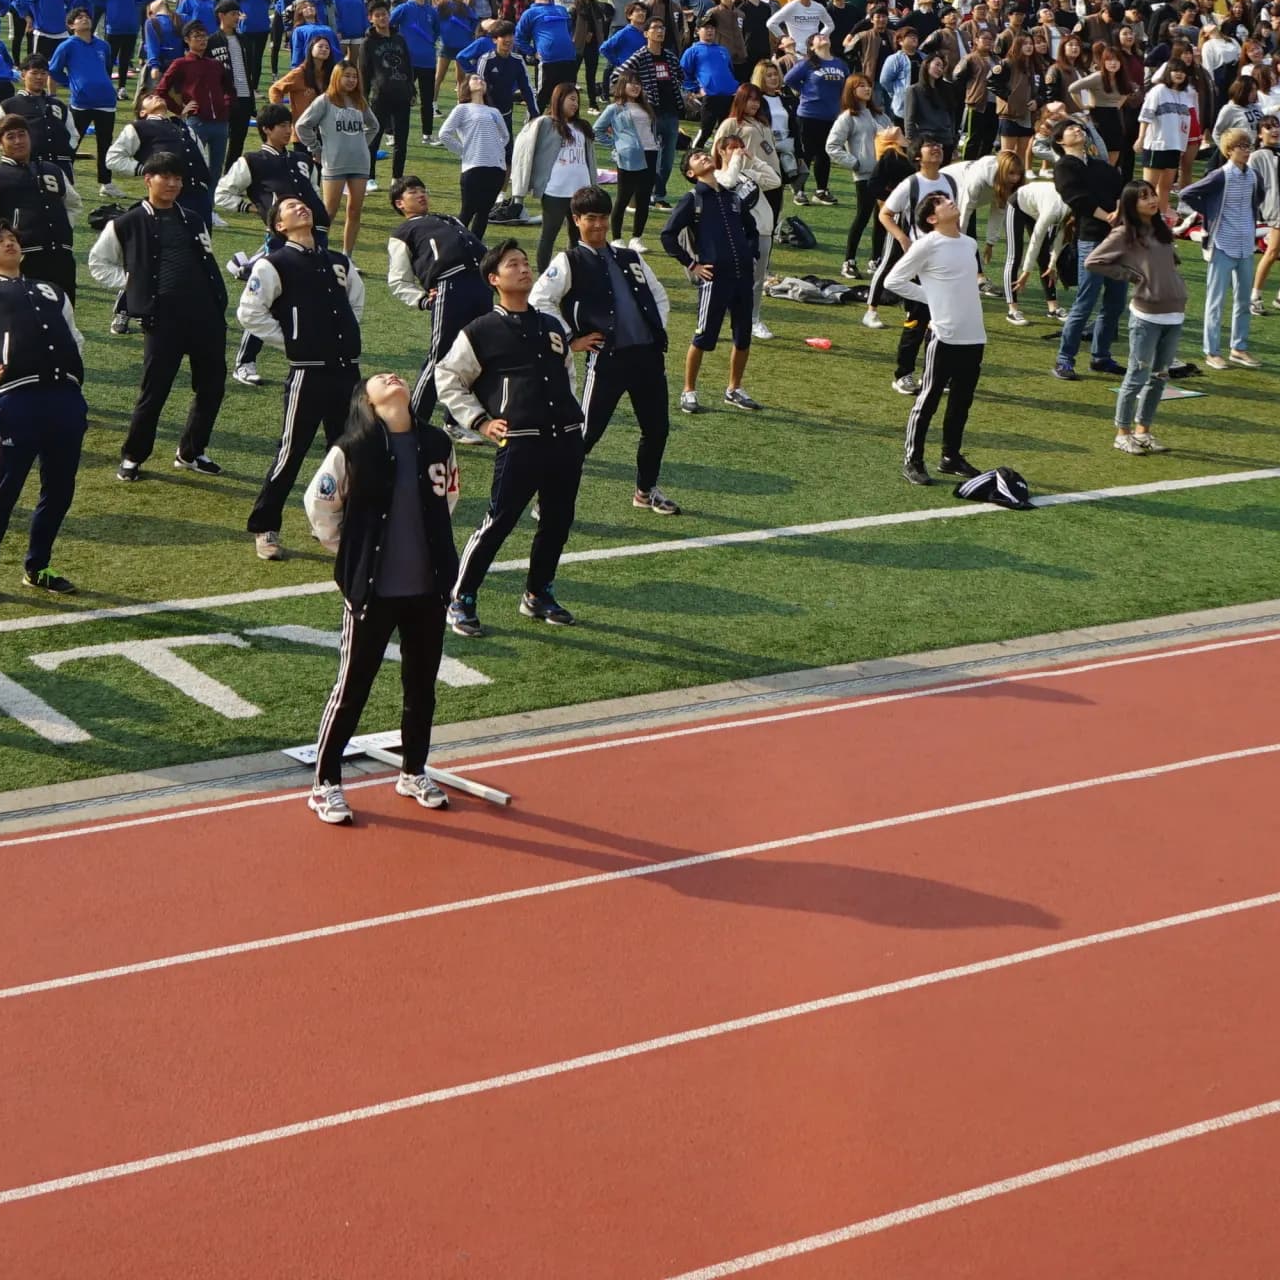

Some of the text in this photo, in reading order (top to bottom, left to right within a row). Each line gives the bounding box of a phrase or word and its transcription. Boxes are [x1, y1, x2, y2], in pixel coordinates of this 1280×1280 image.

[335, 120, 363, 132] BLACK
[42, 174, 59, 193] S
[332, 264, 348, 286] S
[630, 262, 646, 284] S
[548, 331, 564, 355] S
[428, 462, 446, 496] S
